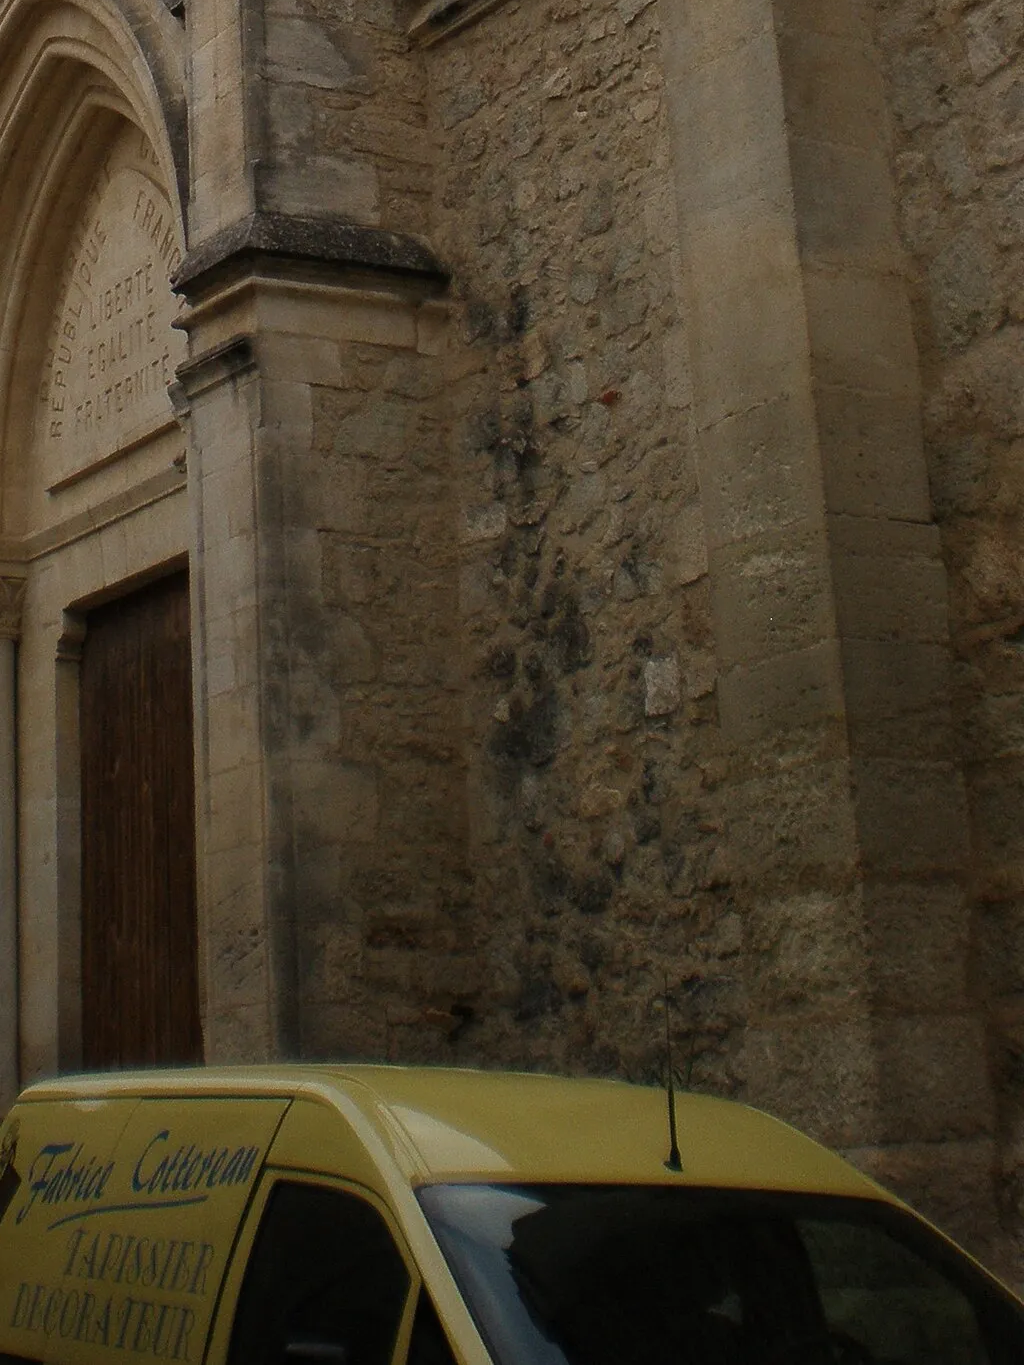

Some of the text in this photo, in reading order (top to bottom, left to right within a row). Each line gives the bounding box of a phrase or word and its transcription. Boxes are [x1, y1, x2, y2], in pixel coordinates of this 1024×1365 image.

[90, 255, 154, 331] LIBERTÉ
[76, 345, 172, 431] FRATERNITÉ
[16, 1142, 116, 1225] Fabrice
[63, 1228, 215, 1295] TAPISSIER
[10, 1282, 196, 1362] DECORATEUR
